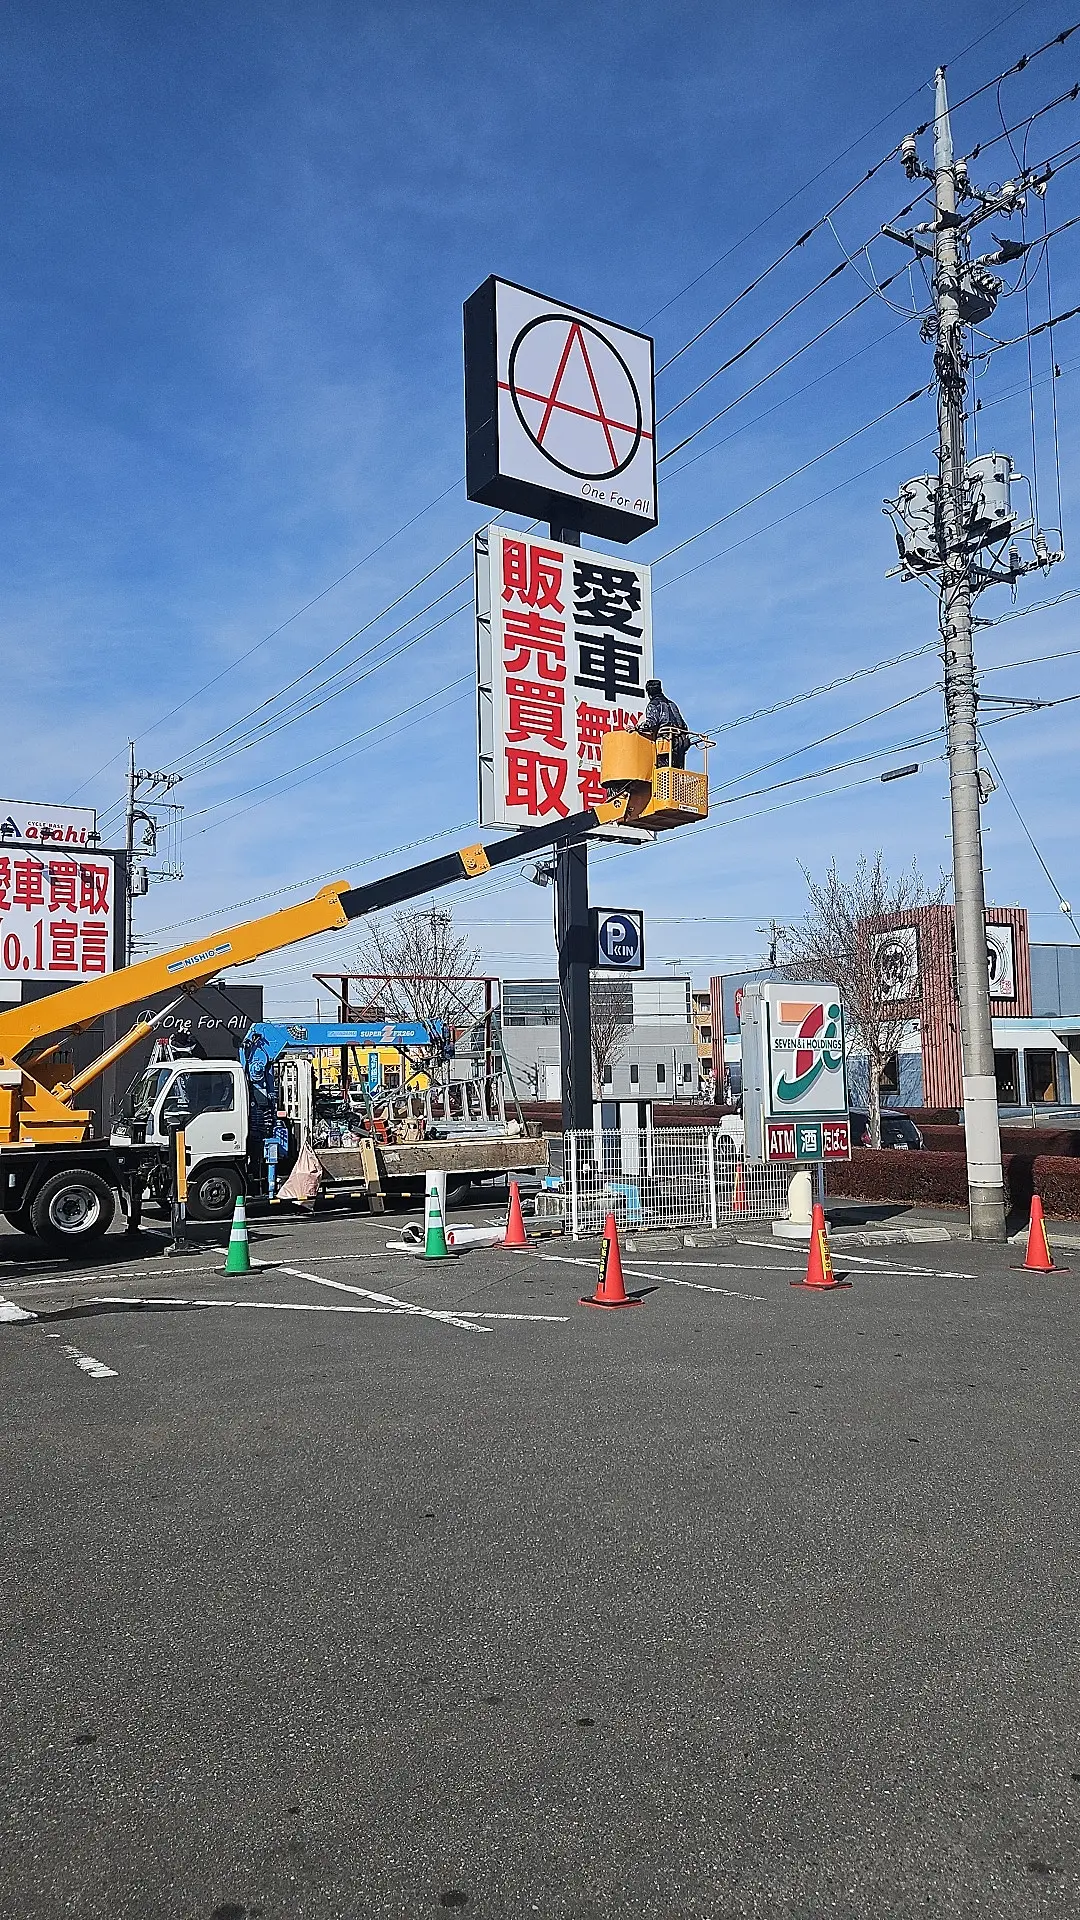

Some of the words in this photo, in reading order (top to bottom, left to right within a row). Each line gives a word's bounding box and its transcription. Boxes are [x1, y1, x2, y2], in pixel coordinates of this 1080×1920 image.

[581, 483, 605, 500] One
[610, 492, 630, 507] For
[633, 498, 650, 513] All
[573, 559, 645, 702] 愛車
[502, 537, 570, 818] 販売買取
[27, 821, 46, 830] CYCLE
[606, 921, 626, 955] P
[184, 950, 215, 966] NISHIO
[163, 1015, 192, 1029] One
[197, 1015, 223, 1029] For
[227, 1015, 248, 1029] All
[360, 1030, 382, 1038] SUPER
[806, 1038, 842, 1050] HOLDINGS
[770, 1129, 795, 1155] ATM
[800, 1129, 818, 1153] 酒
[823, 1127, 848, 1152] たばこ
